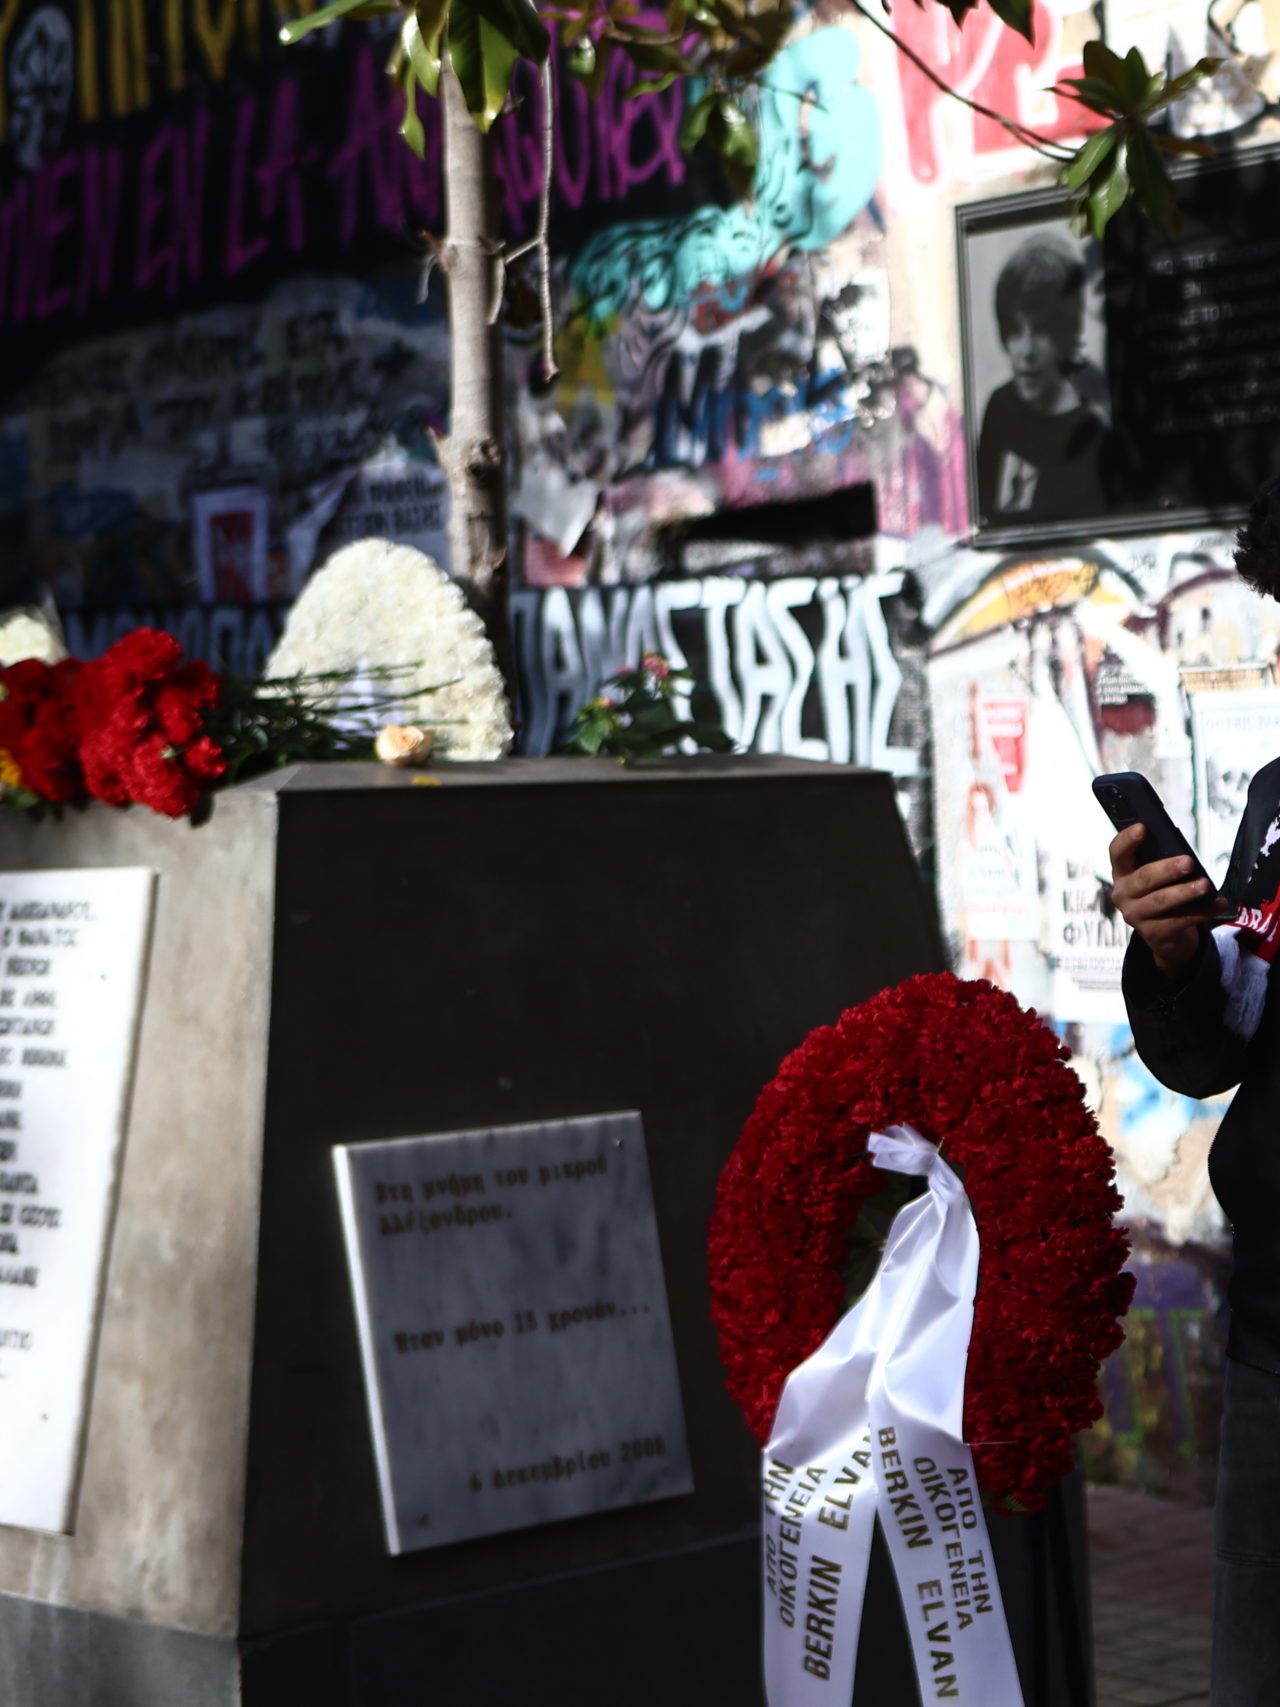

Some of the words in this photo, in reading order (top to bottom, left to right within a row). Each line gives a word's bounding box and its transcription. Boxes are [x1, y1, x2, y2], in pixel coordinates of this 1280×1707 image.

[514, 1309, 538, 1333] 15
[621, 1434, 666, 1463] 2008
[818, 1433, 872, 1532] ELVA
[778, 1465, 828, 1629] ΟΙΚΟΓΕΝΕΙΑ
[878, 1425, 934, 1550] BERKIN
[918, 1579, 959, 1700] ELVAN
[913, 1456, 974, 1631] ΟΙΚΟΓΕΝΕΙΑ
[947, 1466, 978, 1531] ΑΠΟ
[968, 1549, 993, 1615] ΤΗΝ
[804, 1554, 843, 1682] BERKIN
